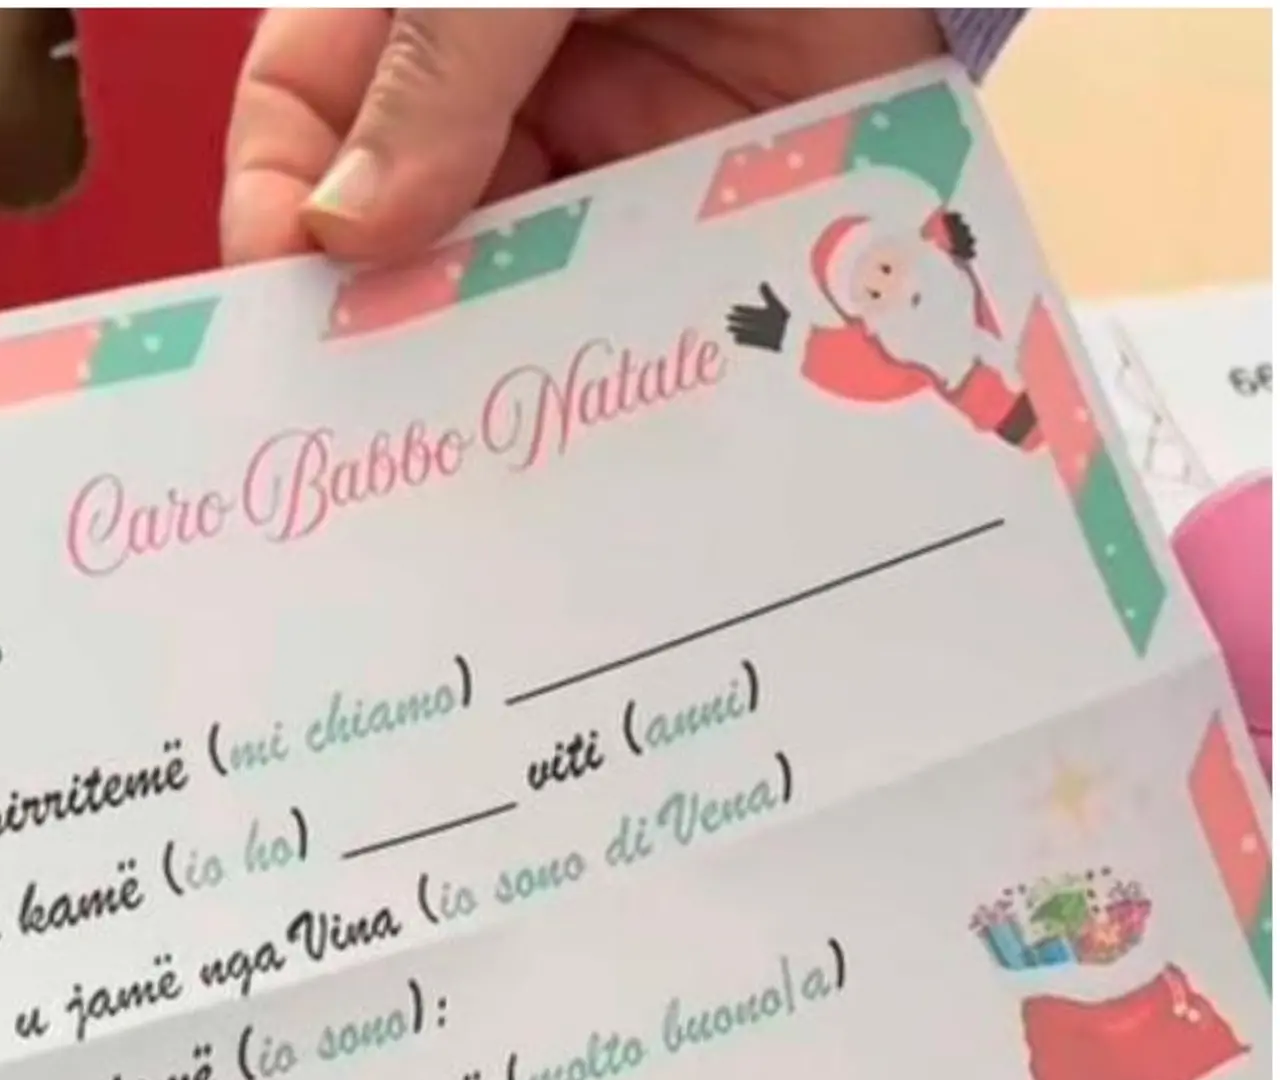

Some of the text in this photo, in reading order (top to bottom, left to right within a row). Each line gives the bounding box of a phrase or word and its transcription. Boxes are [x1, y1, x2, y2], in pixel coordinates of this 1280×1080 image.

[67, 327, 729, 578] Caro Babbo Natale
[19, 858, 144, 935] kamë
[162, 841, 225, 896] (io
[243, 806, 309, 862] ho)
[526, 732, 606, 789] viti
[623, 658, 759, 756] (anni)
[207, 723, 291, 776] (mi
[304, 654, 472, 754] chiamo)
[15, 750, 792, 1042] u jamë nga Vina (io sono di Vena)
[316, 978, 449, 1062] sono):
